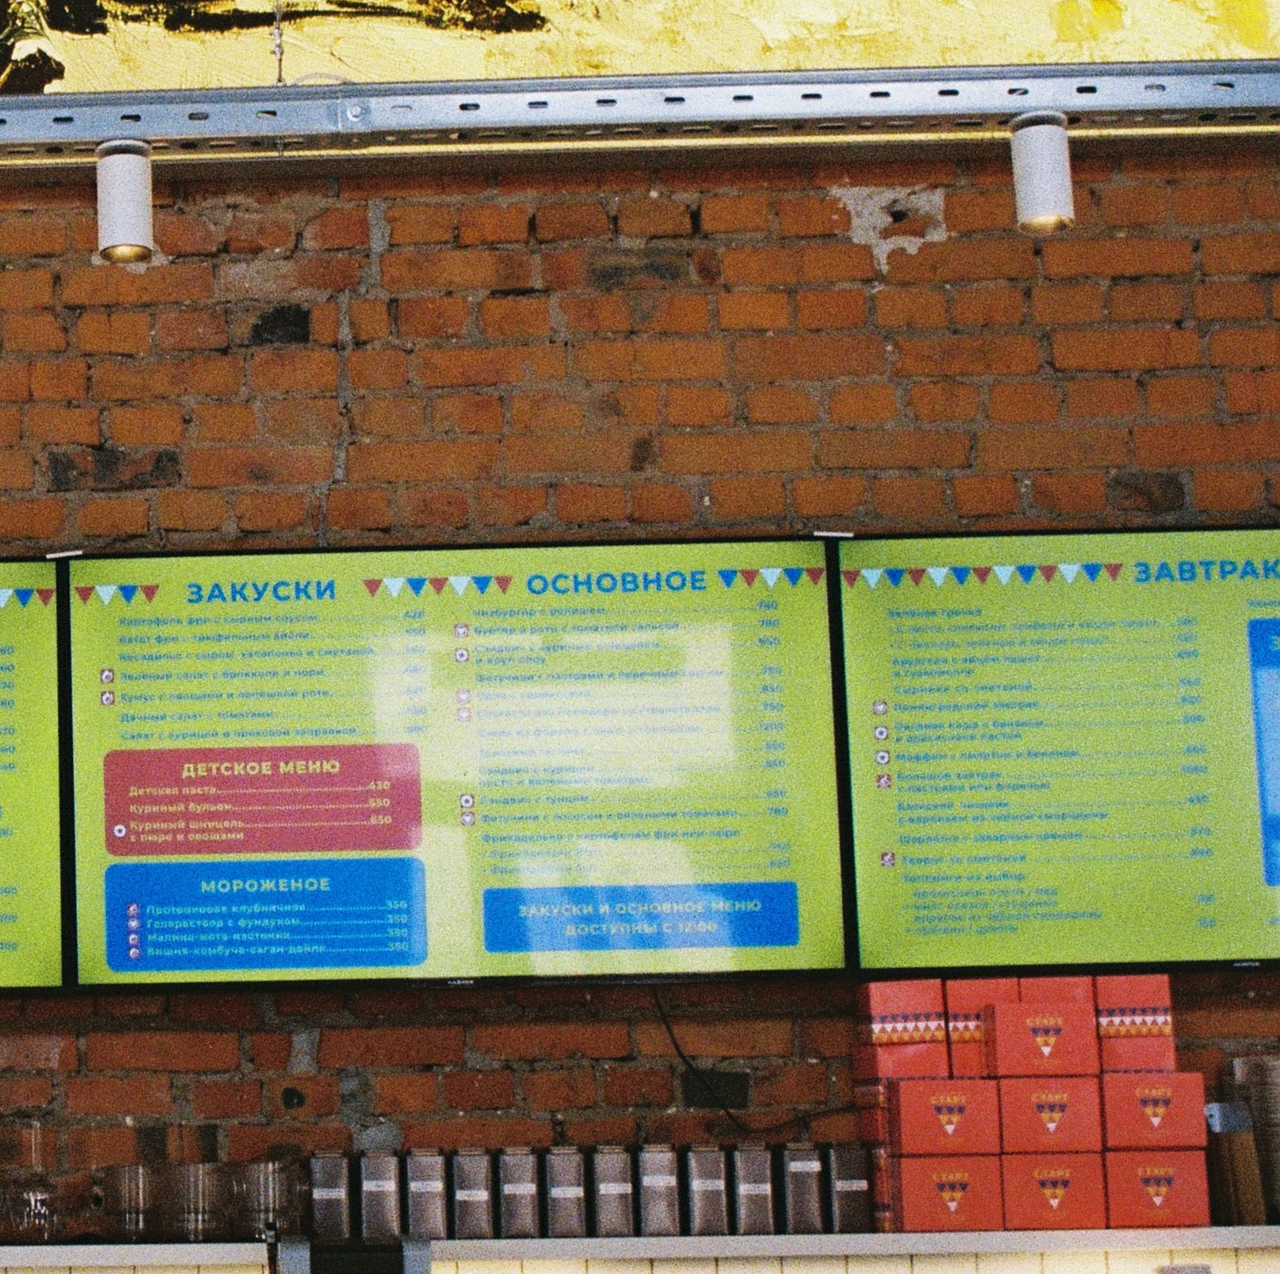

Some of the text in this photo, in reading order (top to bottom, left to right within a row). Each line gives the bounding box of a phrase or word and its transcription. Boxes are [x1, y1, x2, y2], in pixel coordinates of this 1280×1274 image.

[187, 580, 337, 604] ЗАКУСКИ
[526, 570, 707, 596] ОСНОВНОЕ
[181, 759, 341, 779] ДЕТСКОЕ МЕНЮ
[200, 877, 331, 893] МОРОЖЕНОЕ
[518, 899, 761, 917] ЗАКУСКИ И ОСНОВНОЕ МЕНЮ
[565, 923, 657, 937] ДОСТУПНЫ
